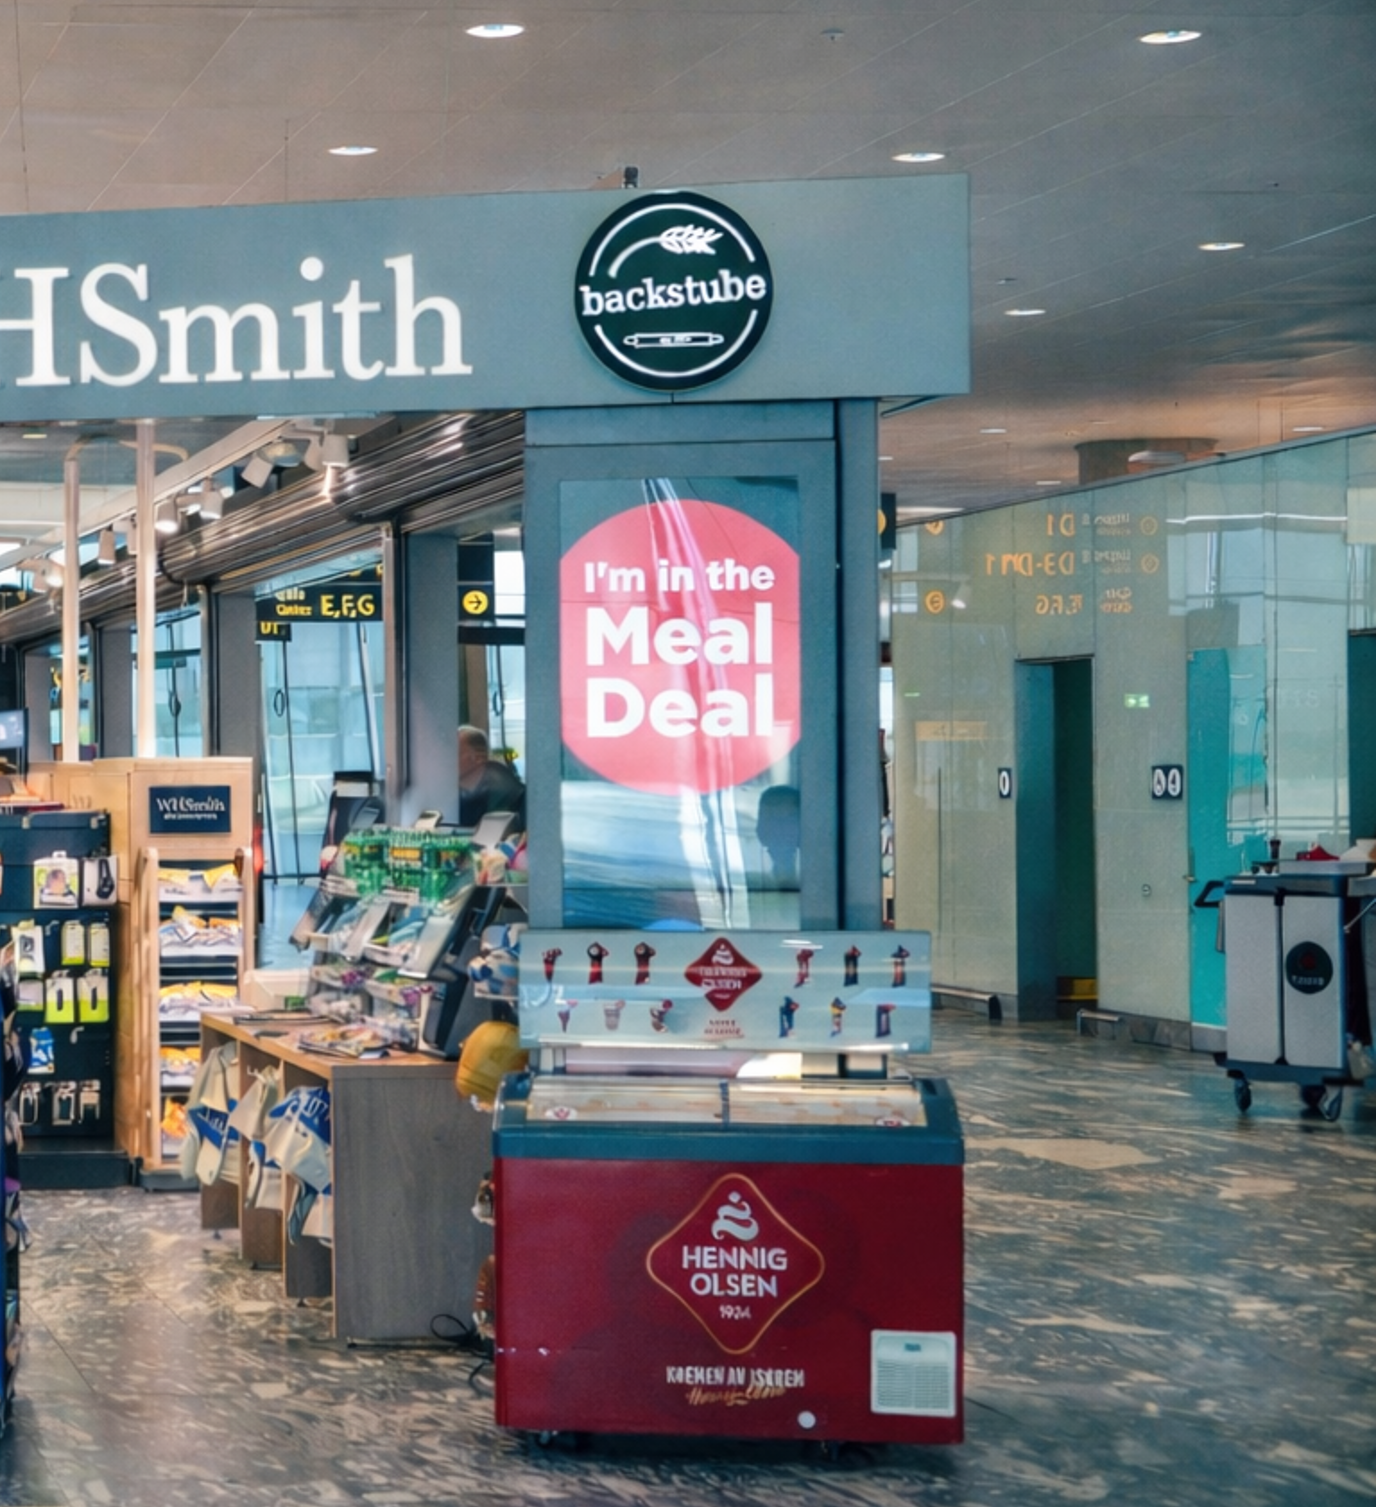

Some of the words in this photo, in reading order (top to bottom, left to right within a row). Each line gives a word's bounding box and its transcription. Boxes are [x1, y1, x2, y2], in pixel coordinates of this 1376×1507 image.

[579, 268, 767, 316] backstube
[584, 561, 646, 593] I'm
[658, 558, 695, 592] in
[706, 558, 776, 591] the
[586, 602, 773, 666] Meal
[587, 672, 773, 738] Deal
[682, 1245, 788, 1271] HENNIG
[690, 1272, 778, 1298] OLSEN
